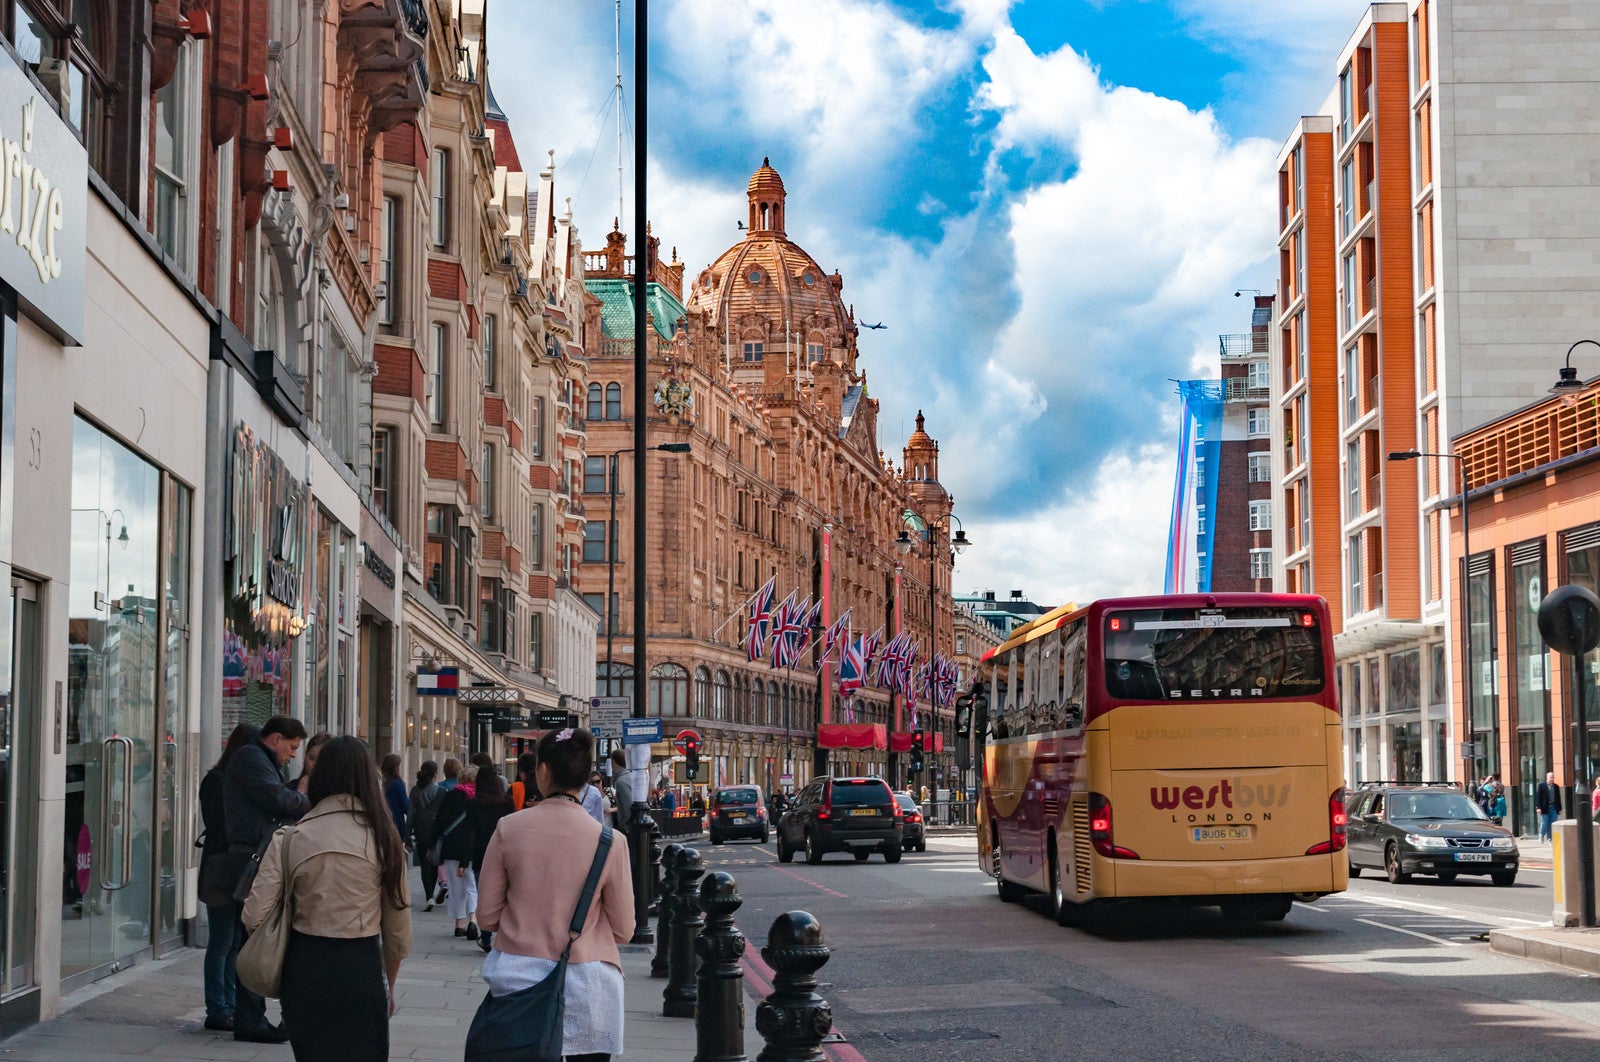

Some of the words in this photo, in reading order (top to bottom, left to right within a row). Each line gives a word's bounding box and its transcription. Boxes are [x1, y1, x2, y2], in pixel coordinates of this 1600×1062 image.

[0, 96, 63, 284] rize
[1170, 688, 1263, 698] SETRA
[1172, 812, 1273, 823] LONDON
[76, 852, 92, 870] SALE
